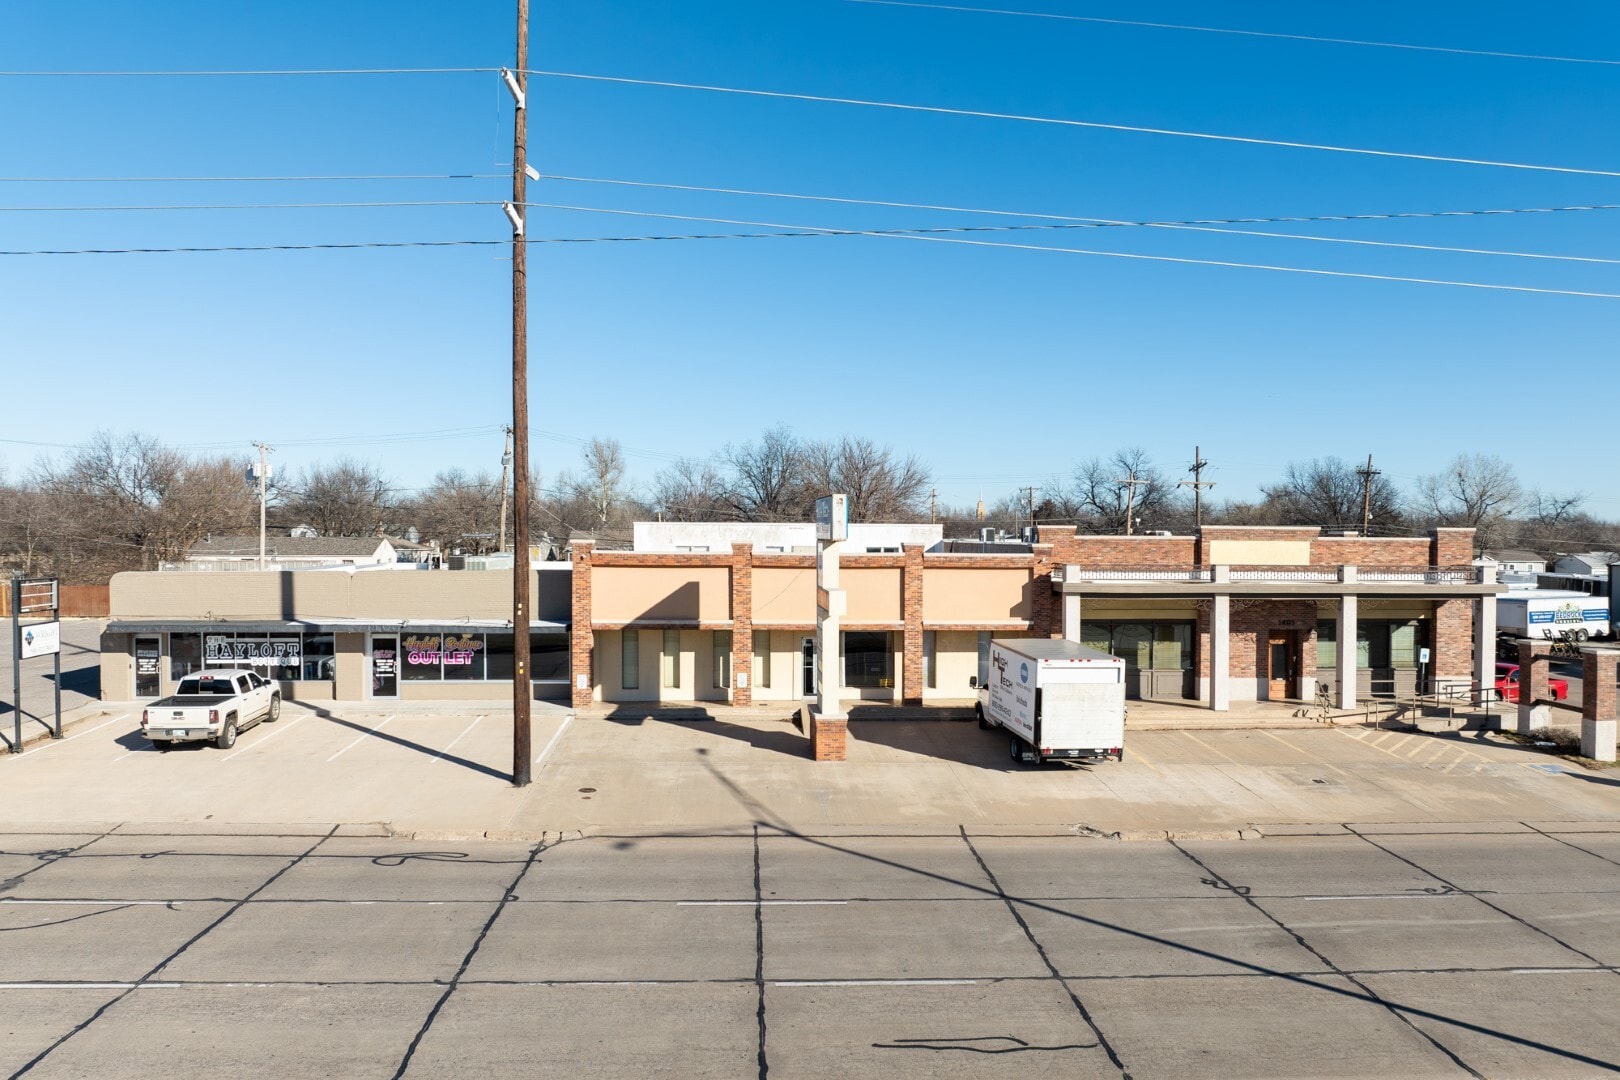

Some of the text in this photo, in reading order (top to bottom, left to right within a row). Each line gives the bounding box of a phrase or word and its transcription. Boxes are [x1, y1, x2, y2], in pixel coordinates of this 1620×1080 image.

[1555, 611, 1583, 620] BEDROCK
[206, 636, 227, 645] THE
[206, 644, 299, 659] HAYLOFT
[251, 657, 300, 666] BOUTIQUE
